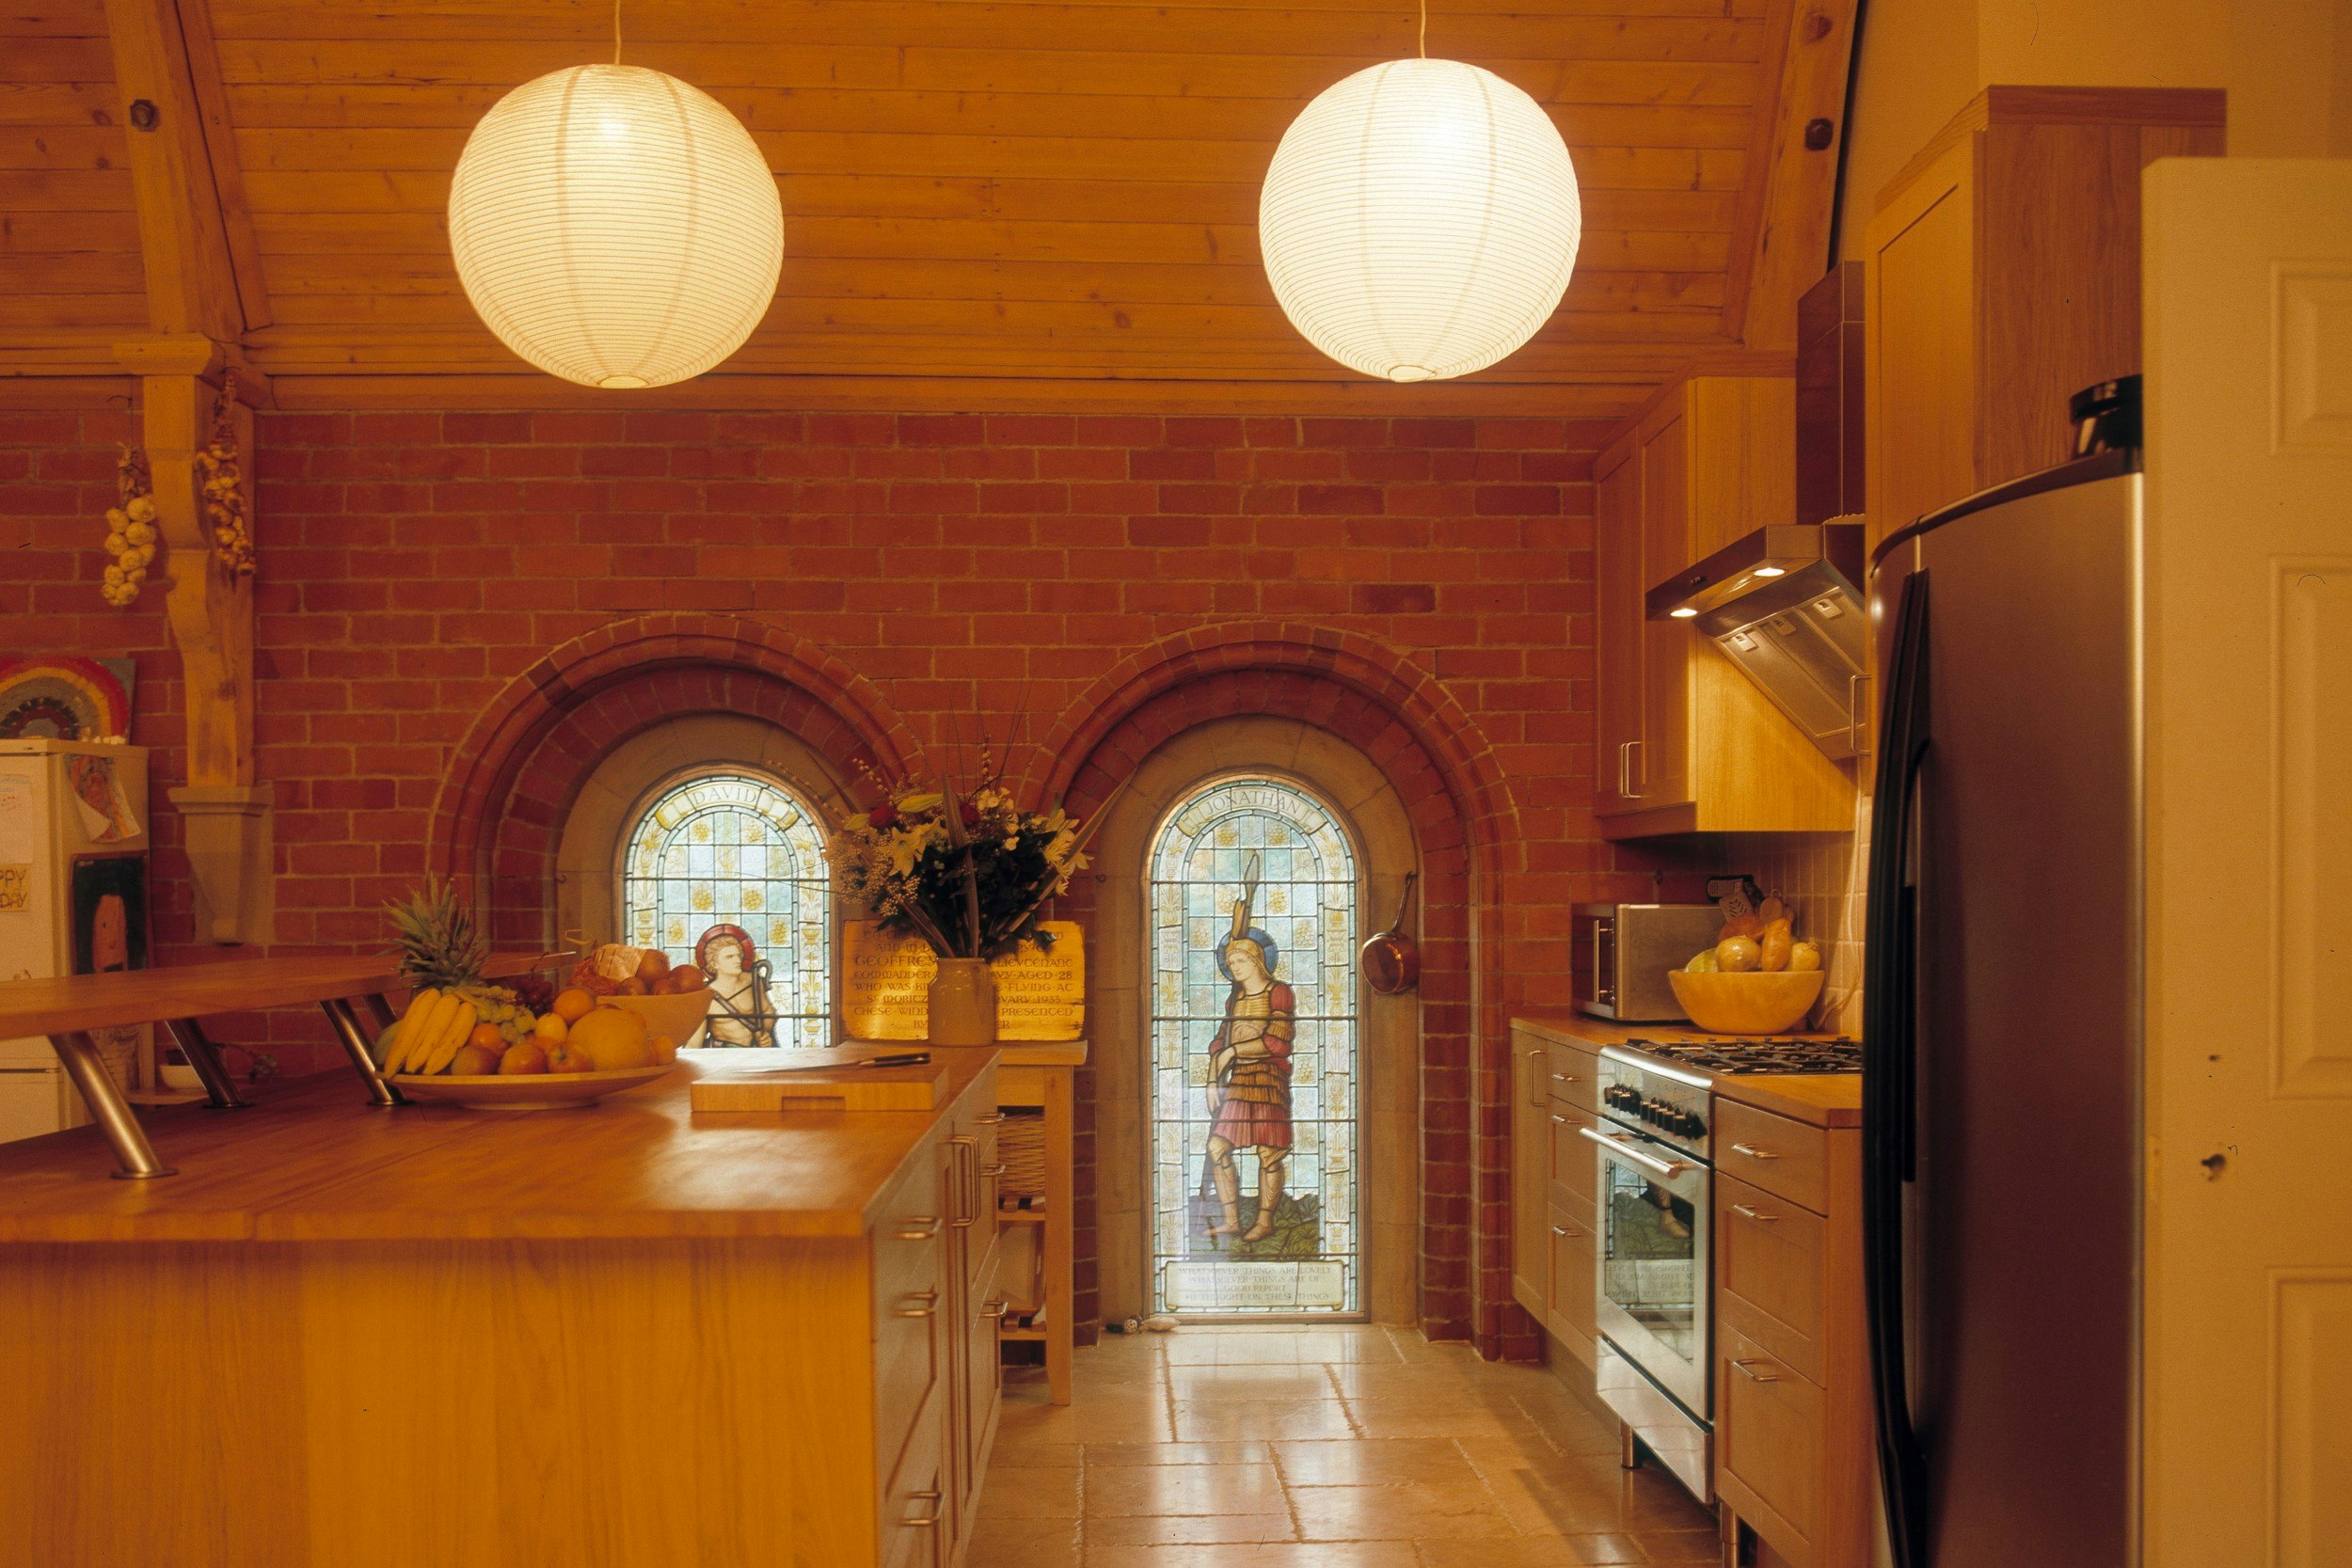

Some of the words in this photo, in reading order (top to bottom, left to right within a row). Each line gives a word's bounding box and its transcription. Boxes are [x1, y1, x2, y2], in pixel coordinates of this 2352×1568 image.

[691, 785, 757, 806] DAVID
[1205, 790, 1302, 816] JONATHAN
[855, 955, 937, 967] GEOFFREY
[853, 970, 931, 979] COMMANDER
[1017, 971, 1053, 980] AGED
[1058, 971, 1073, 980] 28
[855, 983, 882, 991] WHO
[888, 983, 912, 991] WAS
[1008, 983, 1051, 992] FLYING
[1057, 983, 1073, 992] AT
[853, 1006, 893, 1016] THESE
[899, 1006, 929, 1016] WIND
[1002, 1007, 1073, 1017] PRESENTED
[1244, 1266, 1277, 1275] THINGS
